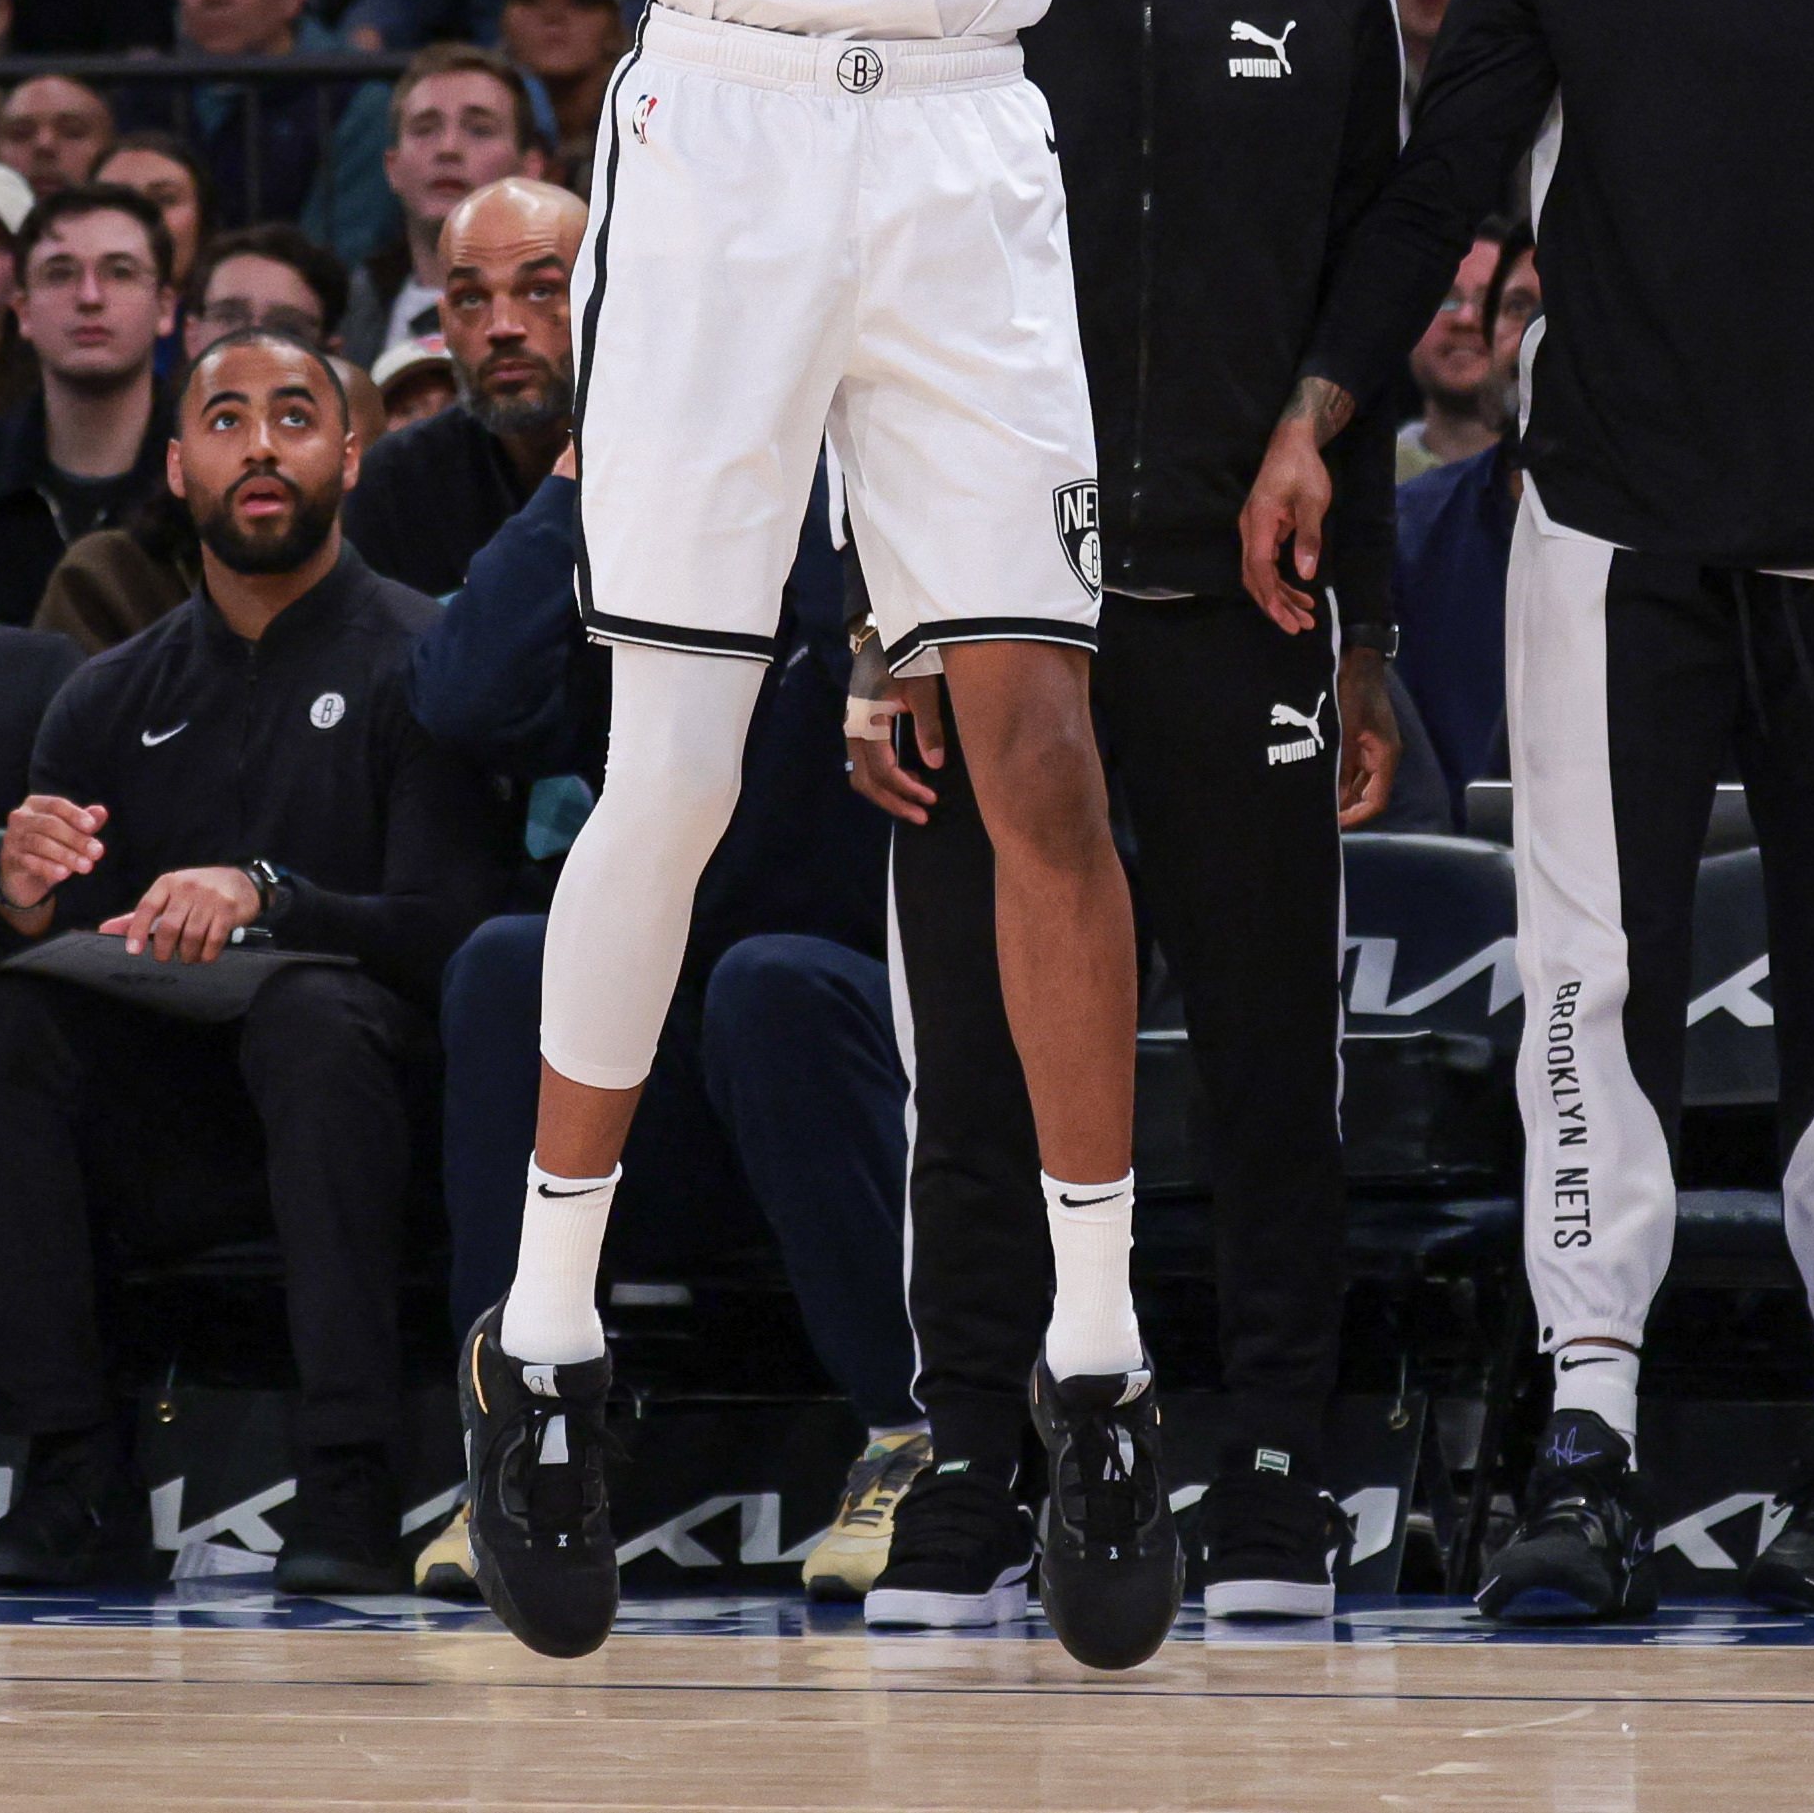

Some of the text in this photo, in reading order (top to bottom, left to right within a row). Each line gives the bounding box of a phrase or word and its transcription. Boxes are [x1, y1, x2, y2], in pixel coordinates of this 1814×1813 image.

[1228, 57, 1282, 79] PUMA
[1267, 737, 1317, 767] PUMA
[1546, 980, 1593, 1250] BROOKLYN NETS
